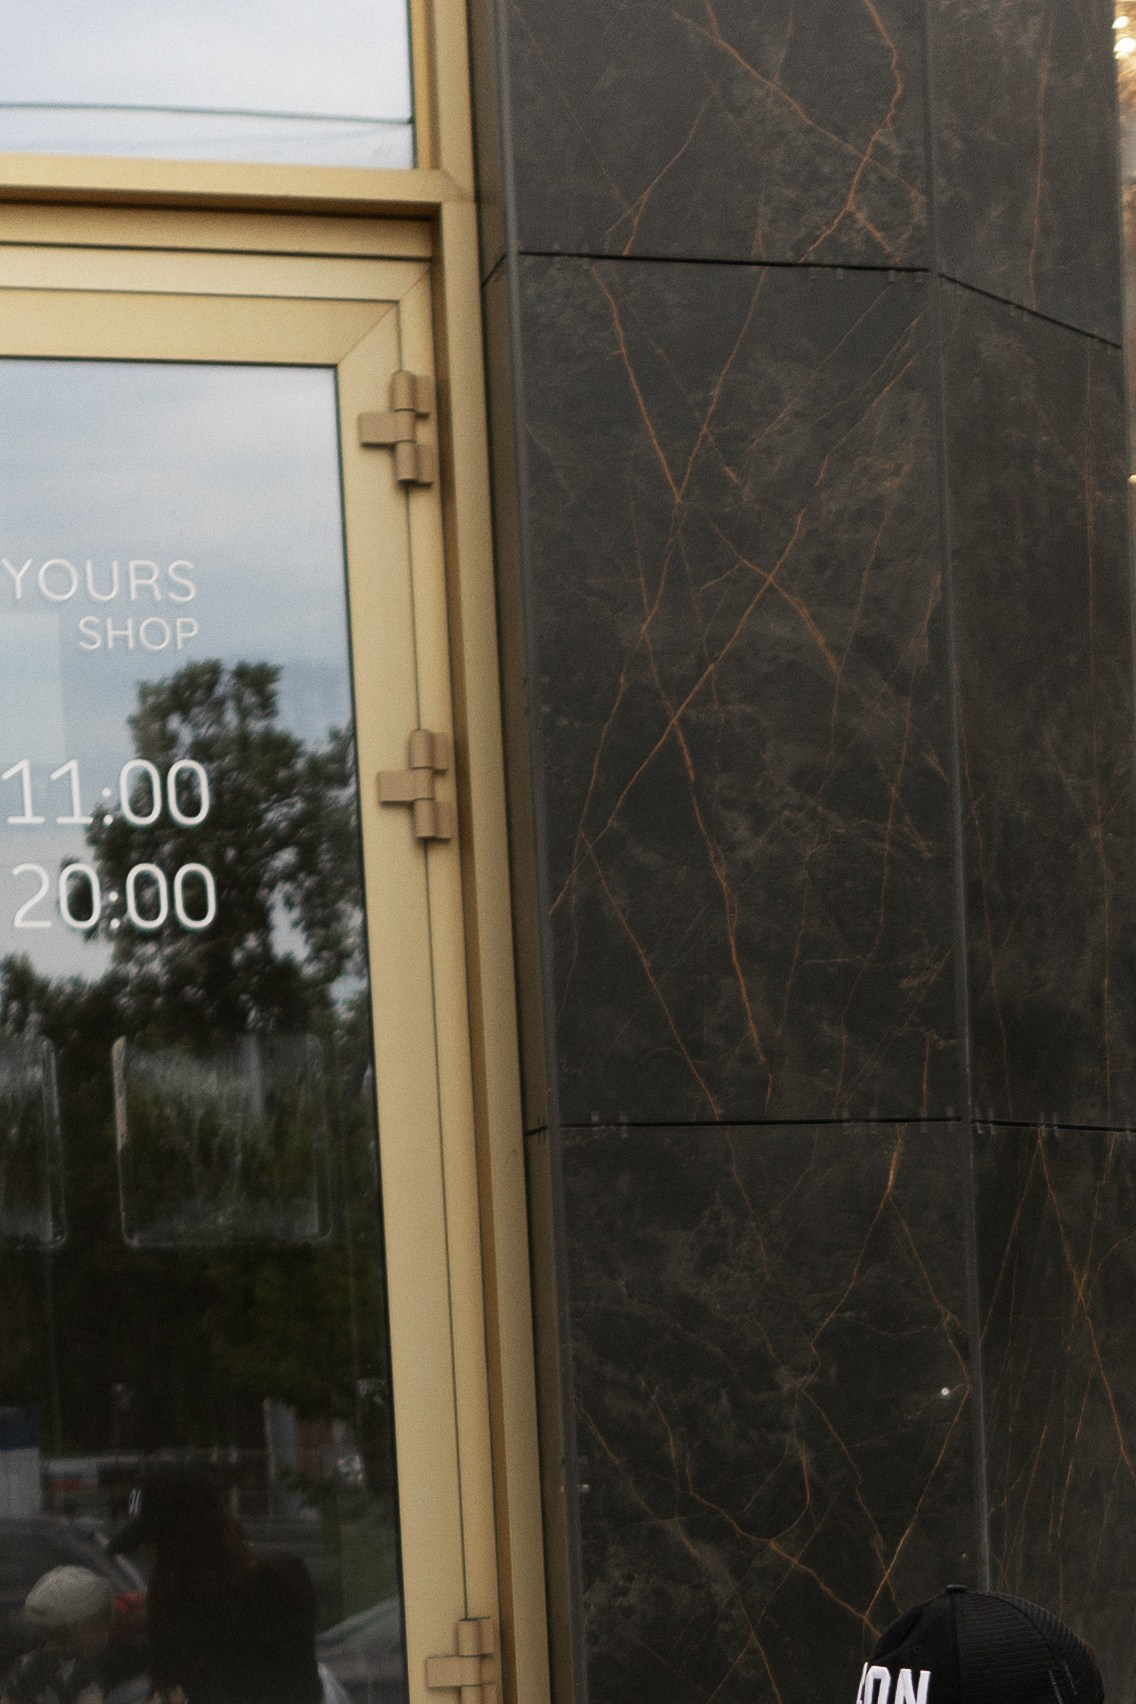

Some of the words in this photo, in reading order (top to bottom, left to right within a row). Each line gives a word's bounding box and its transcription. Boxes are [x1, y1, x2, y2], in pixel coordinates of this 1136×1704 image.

[1, 558, 197, 602] YOURS
[78, 616, 199, 650] SHOP
[2, 758, 210, 825] 11:00
[11, 862, 216, 929] 20:00
